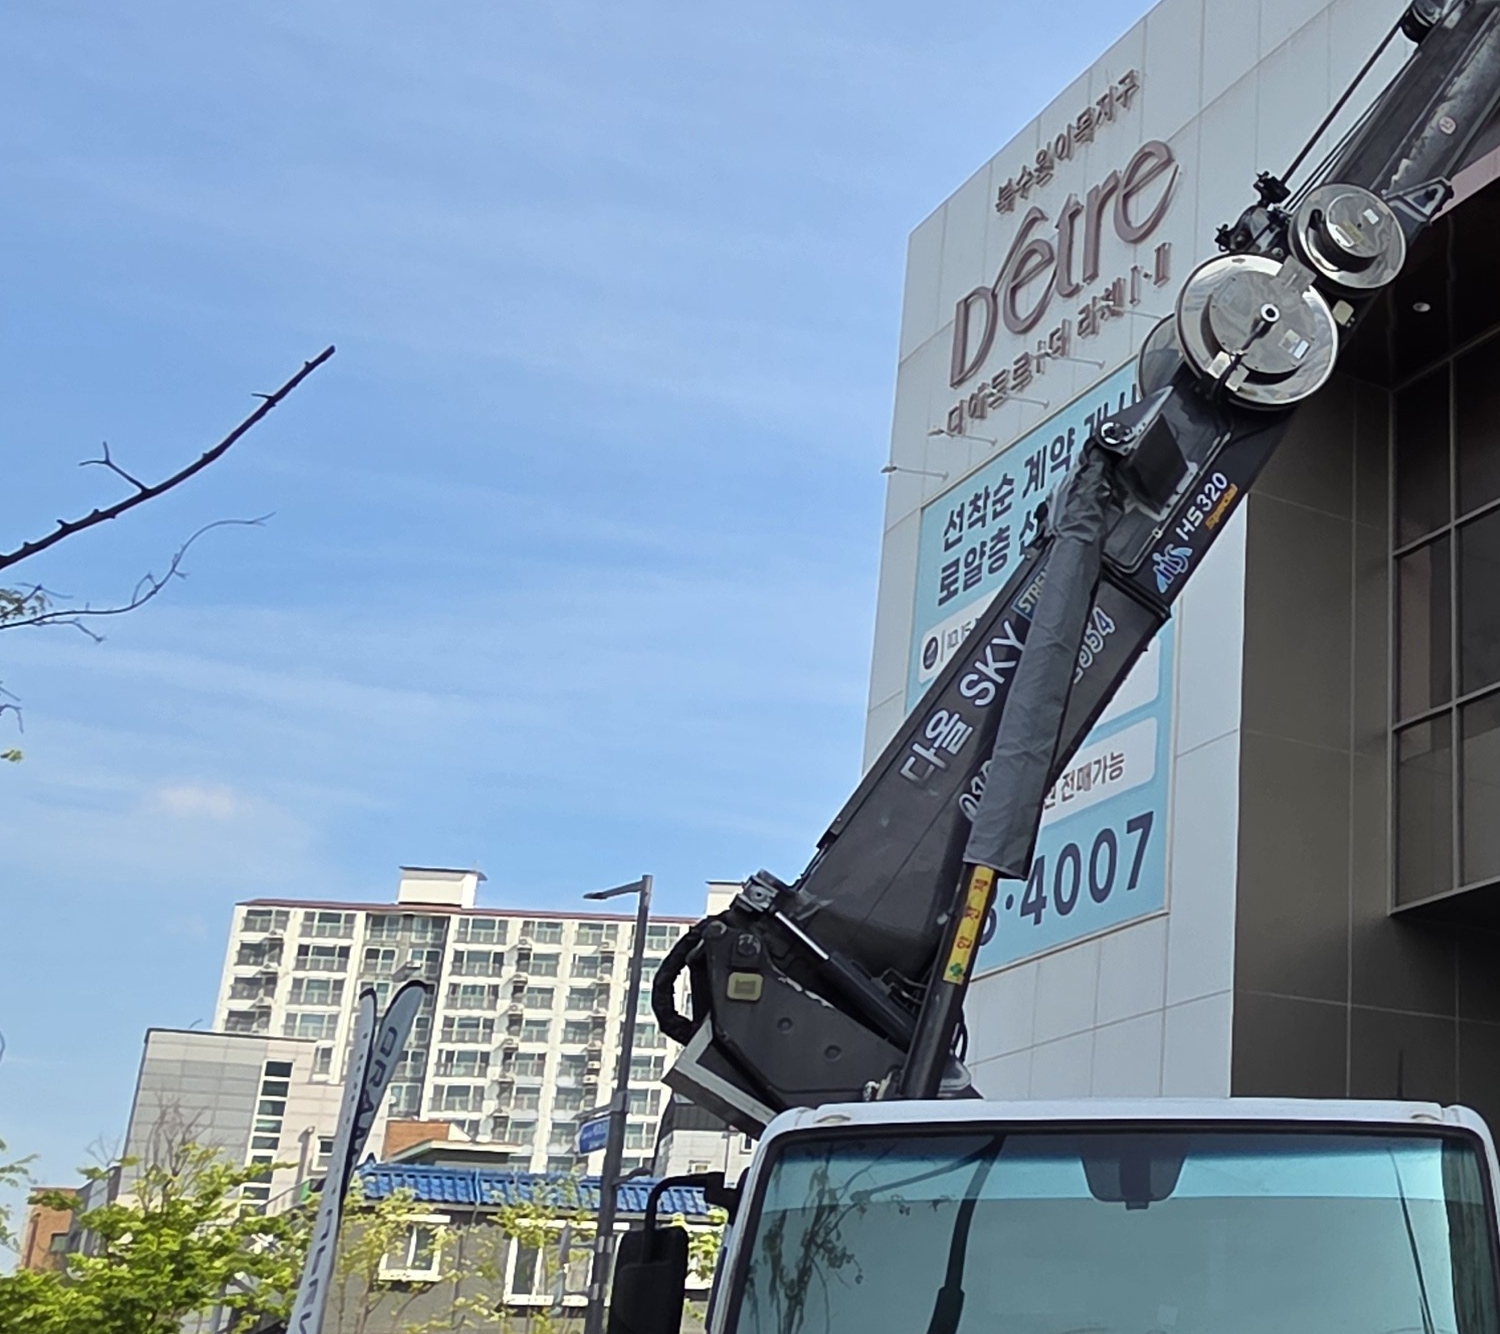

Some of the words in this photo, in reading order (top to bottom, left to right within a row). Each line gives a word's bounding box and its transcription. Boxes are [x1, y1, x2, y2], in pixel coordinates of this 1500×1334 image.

[943, 473, 1015, 552] 선착순
[1022, 427, 1076, 499] 계약
[1175, 472, 1228, 541] HS320
[938, 524, 1010, 606] 로얄층
[900, 708, 974, 784] 다올
[959, 620, 1028, 707] SKY
